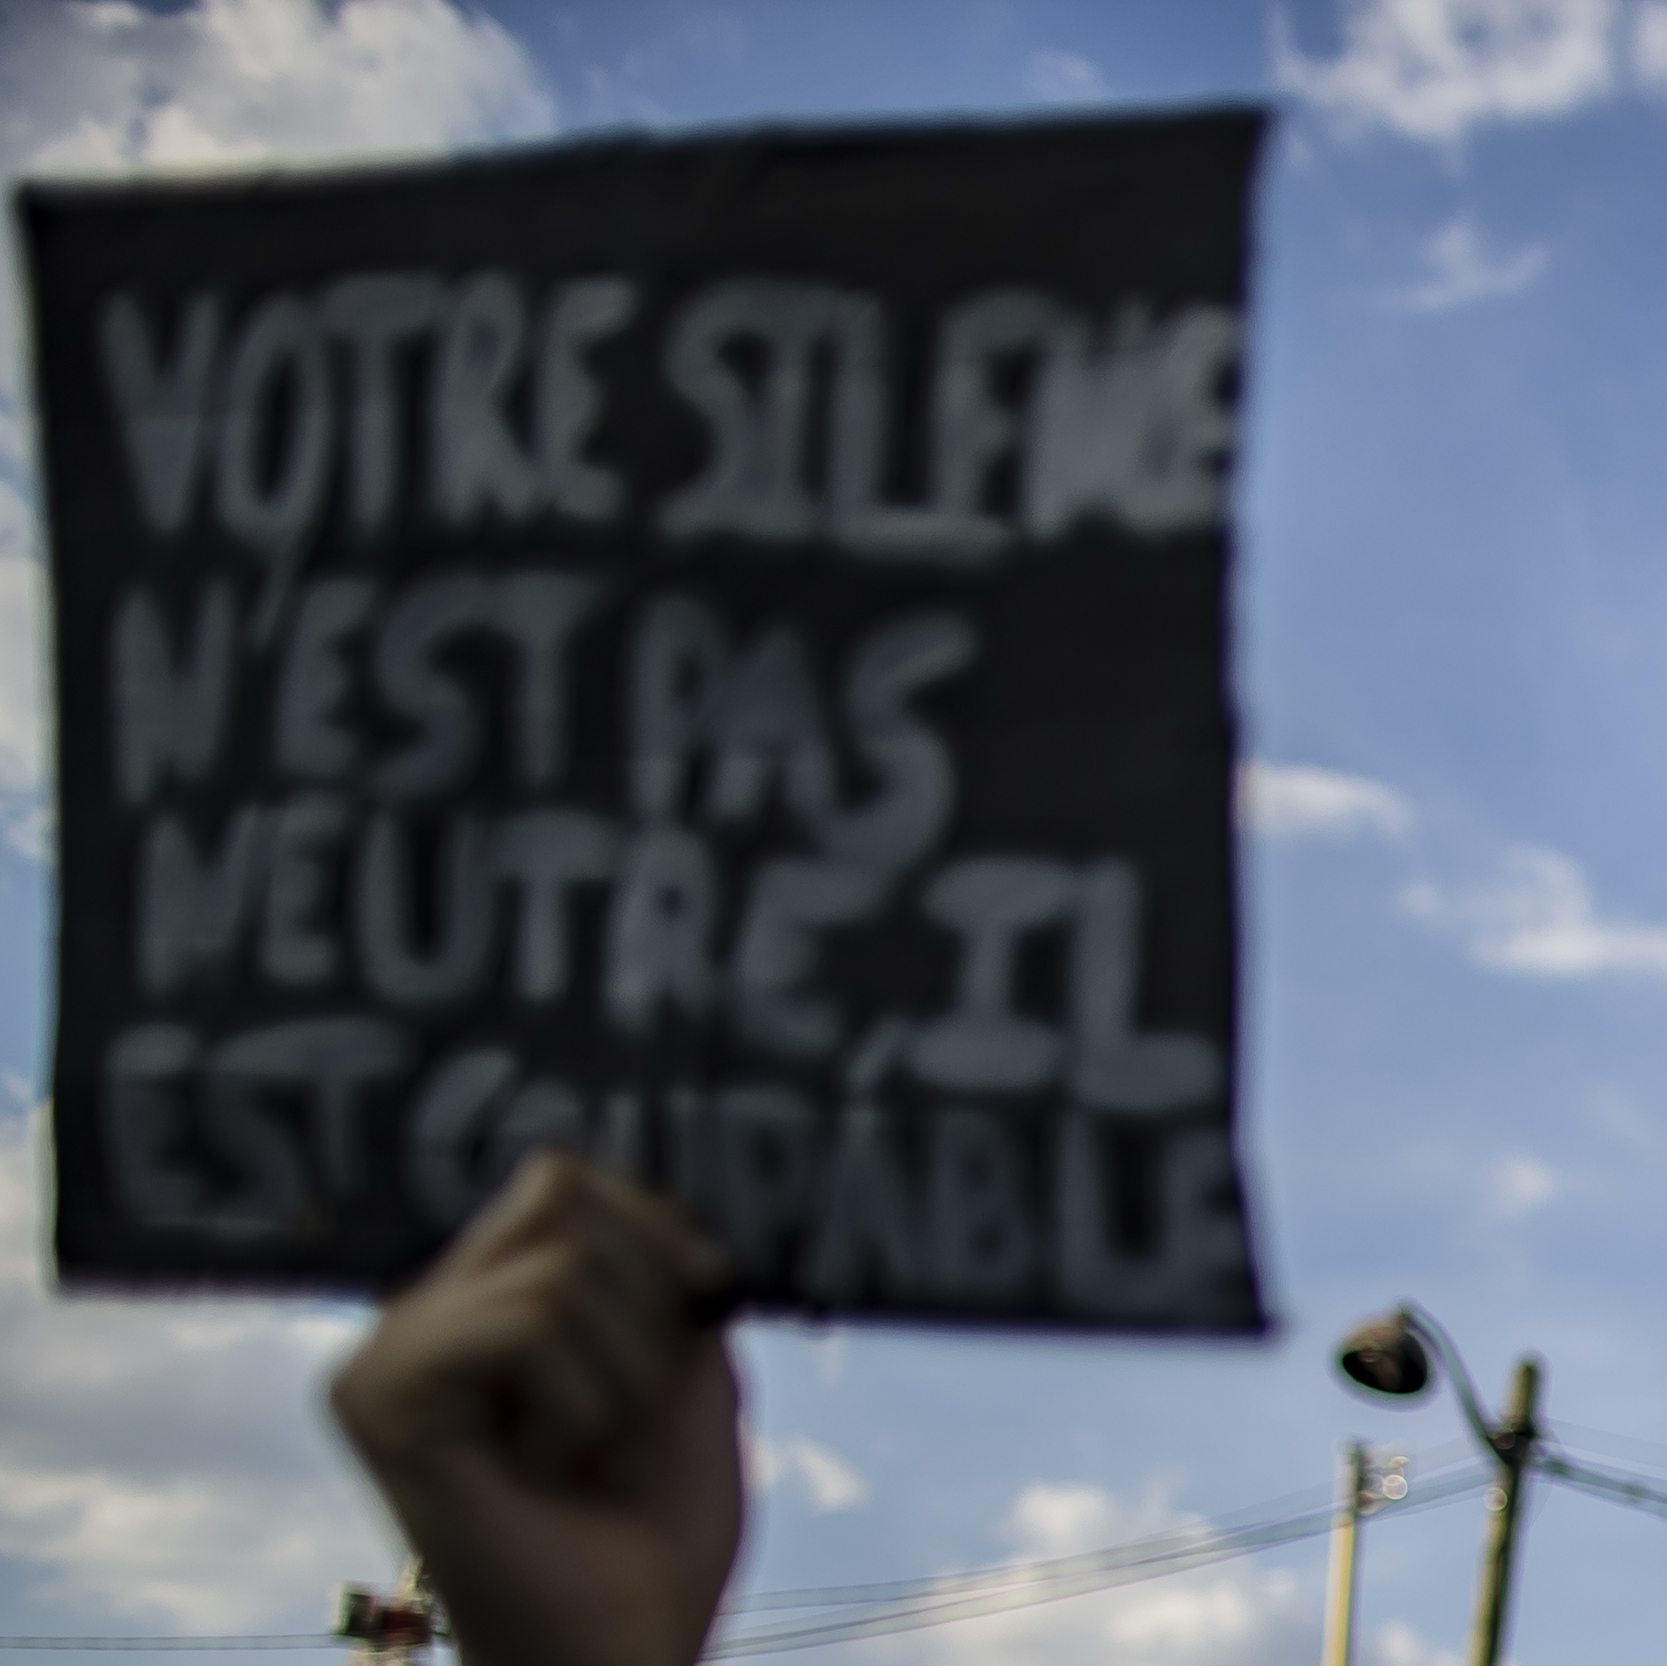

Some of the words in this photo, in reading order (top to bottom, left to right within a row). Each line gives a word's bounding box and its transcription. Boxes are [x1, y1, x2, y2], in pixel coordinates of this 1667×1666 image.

[98, 276, 636, 550] VOTRE
[105, 567, 608, 805] N'EST
[632, 602, 974, 880] PAS
[916, 862, 1224, 1108] IL
[100, 1014, 413, 1234] EST
